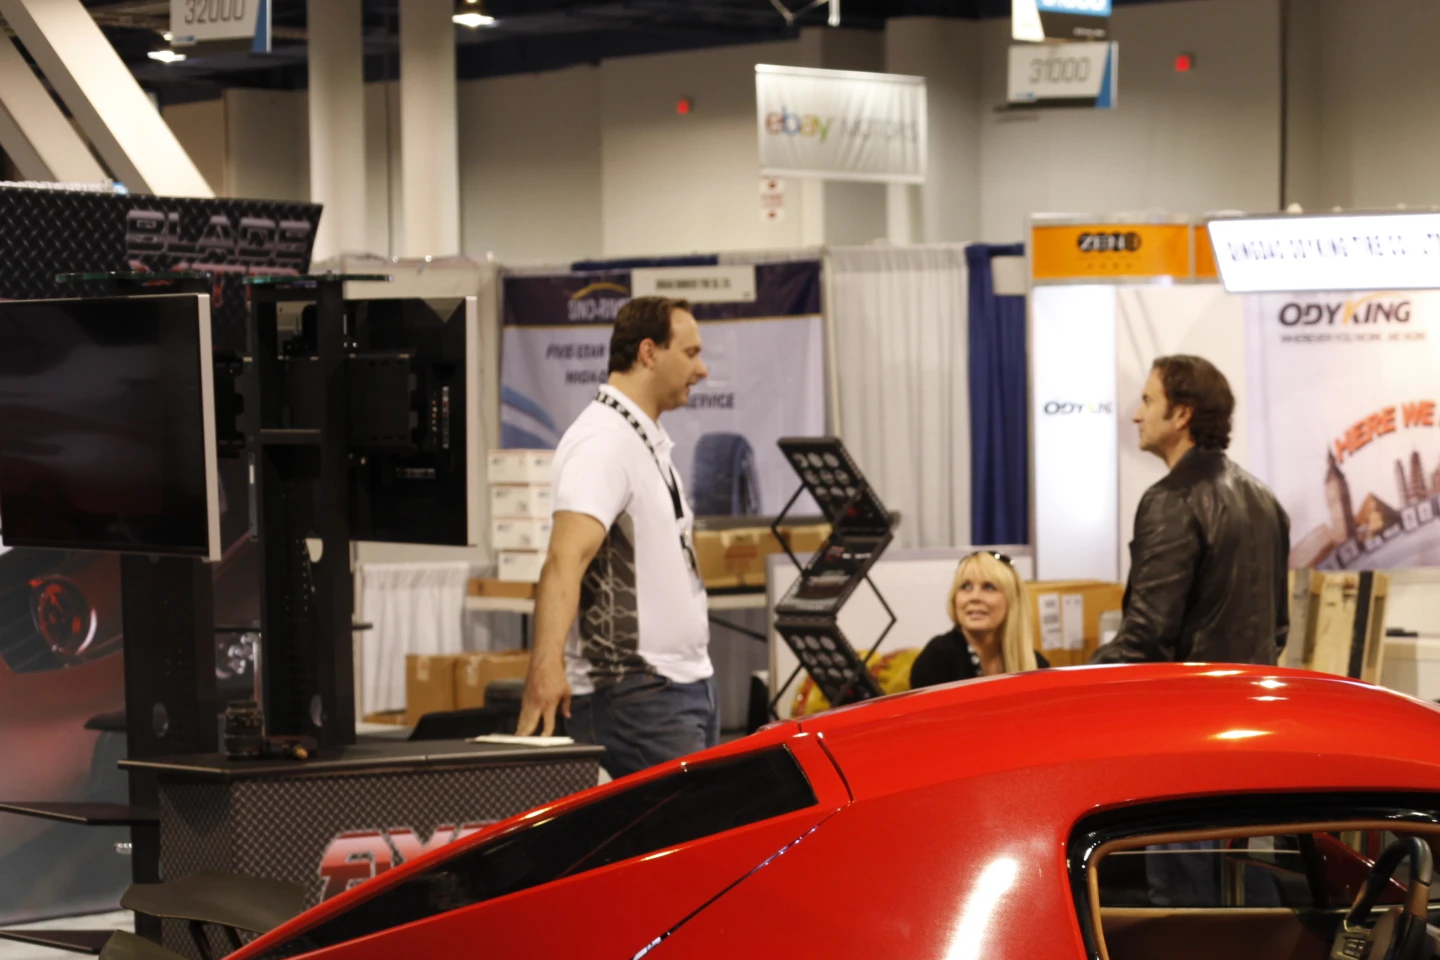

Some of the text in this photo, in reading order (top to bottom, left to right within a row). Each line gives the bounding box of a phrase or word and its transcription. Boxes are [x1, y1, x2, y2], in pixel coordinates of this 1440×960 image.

[765, 105, 834, 143] ebay
[1278, 300, 1412, 327] ODYKING
[686, 392, 735, 410] ERVICE
[1334, 406, 1396, 464] HERE
[1401, 400, 1437, 428] WE
